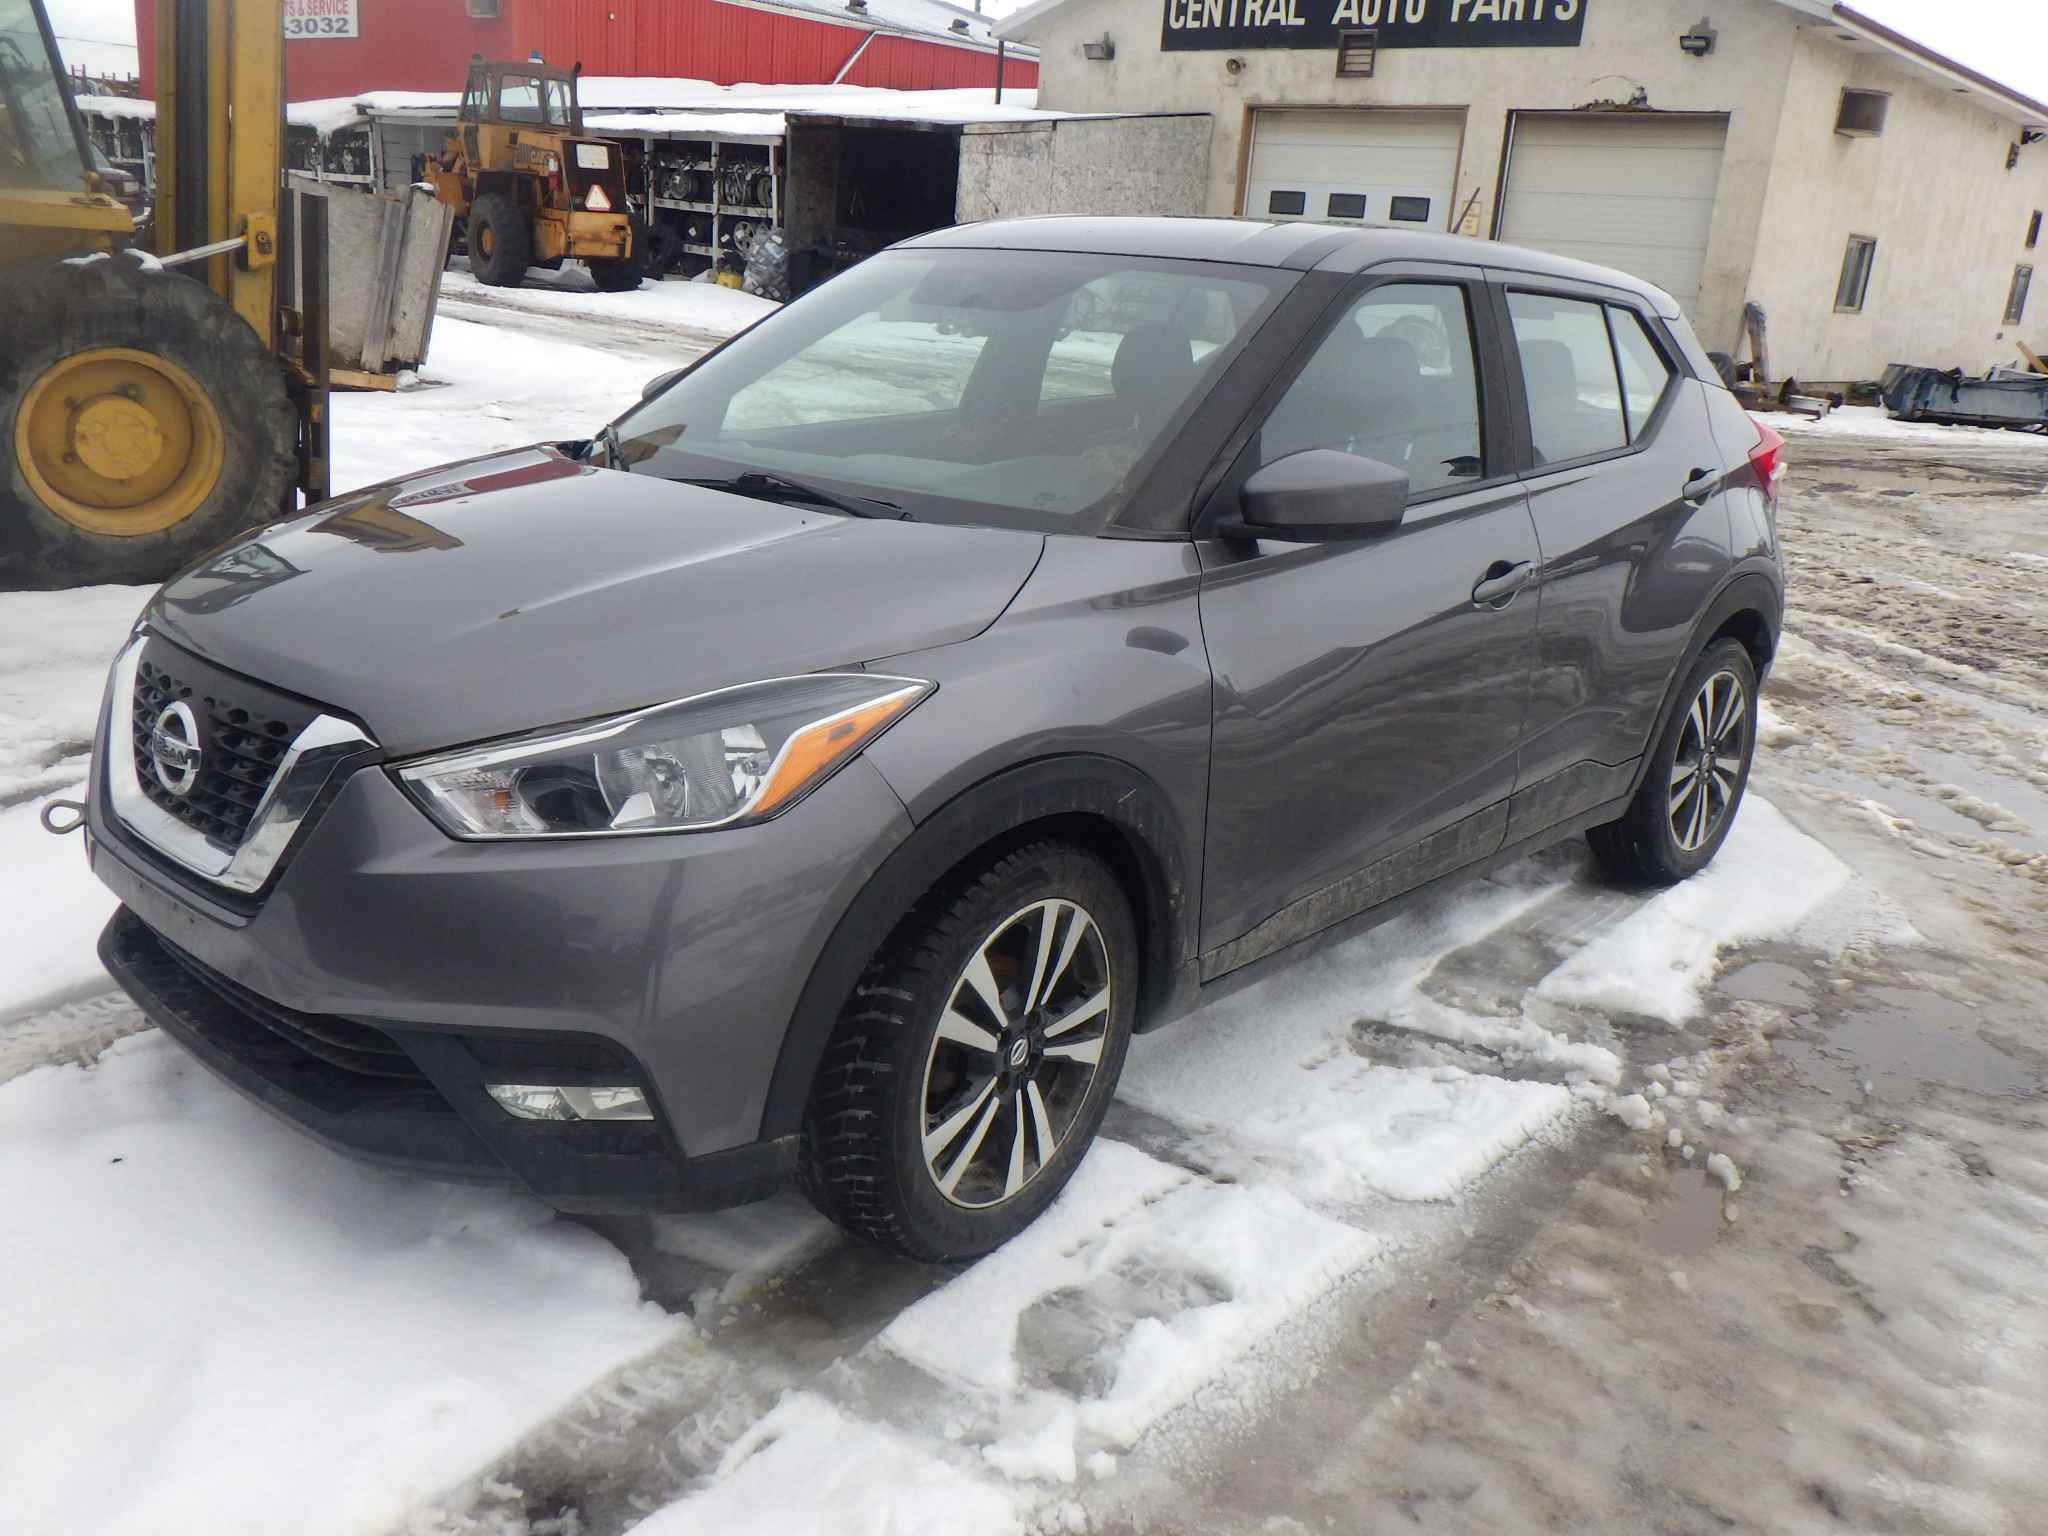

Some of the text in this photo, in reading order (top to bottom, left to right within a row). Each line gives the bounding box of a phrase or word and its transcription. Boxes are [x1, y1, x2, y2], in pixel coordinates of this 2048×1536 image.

[306, 0, 349, 16] SERVICE
[1169, 0, 1579, 29] CENTRAL AUTO PARTS
